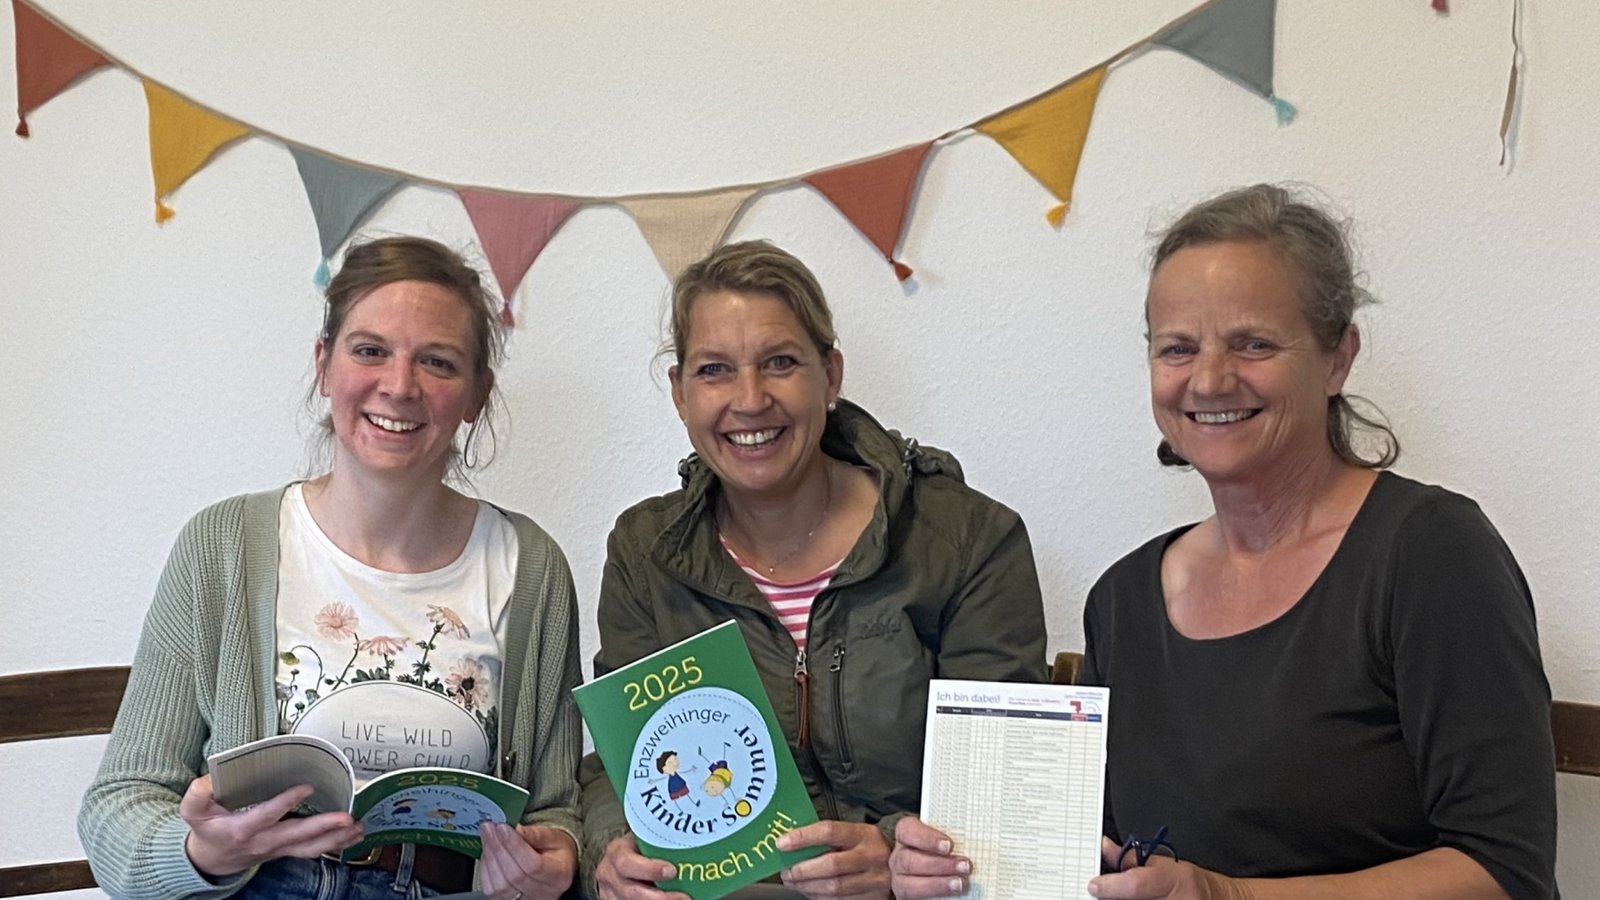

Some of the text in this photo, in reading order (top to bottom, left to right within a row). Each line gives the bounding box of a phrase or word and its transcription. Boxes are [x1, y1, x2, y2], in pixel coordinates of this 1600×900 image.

[623, 655, 704, 712] 2025
[936, 691, 951, 702] Ich
[953, 692, 969, 702] bin
[970, 693, 1001, 704] dabei!
[341, 720, 453, 748] LIVE WILD
[633, 707, 732, 780] Enzweihinger
[342, 746, 399, 767] OWER
[397, 774, 479, 789] 2025
[640, 723, 767, 835] Kinder Sommer
[677, 810, 798, 883] mach mit!
